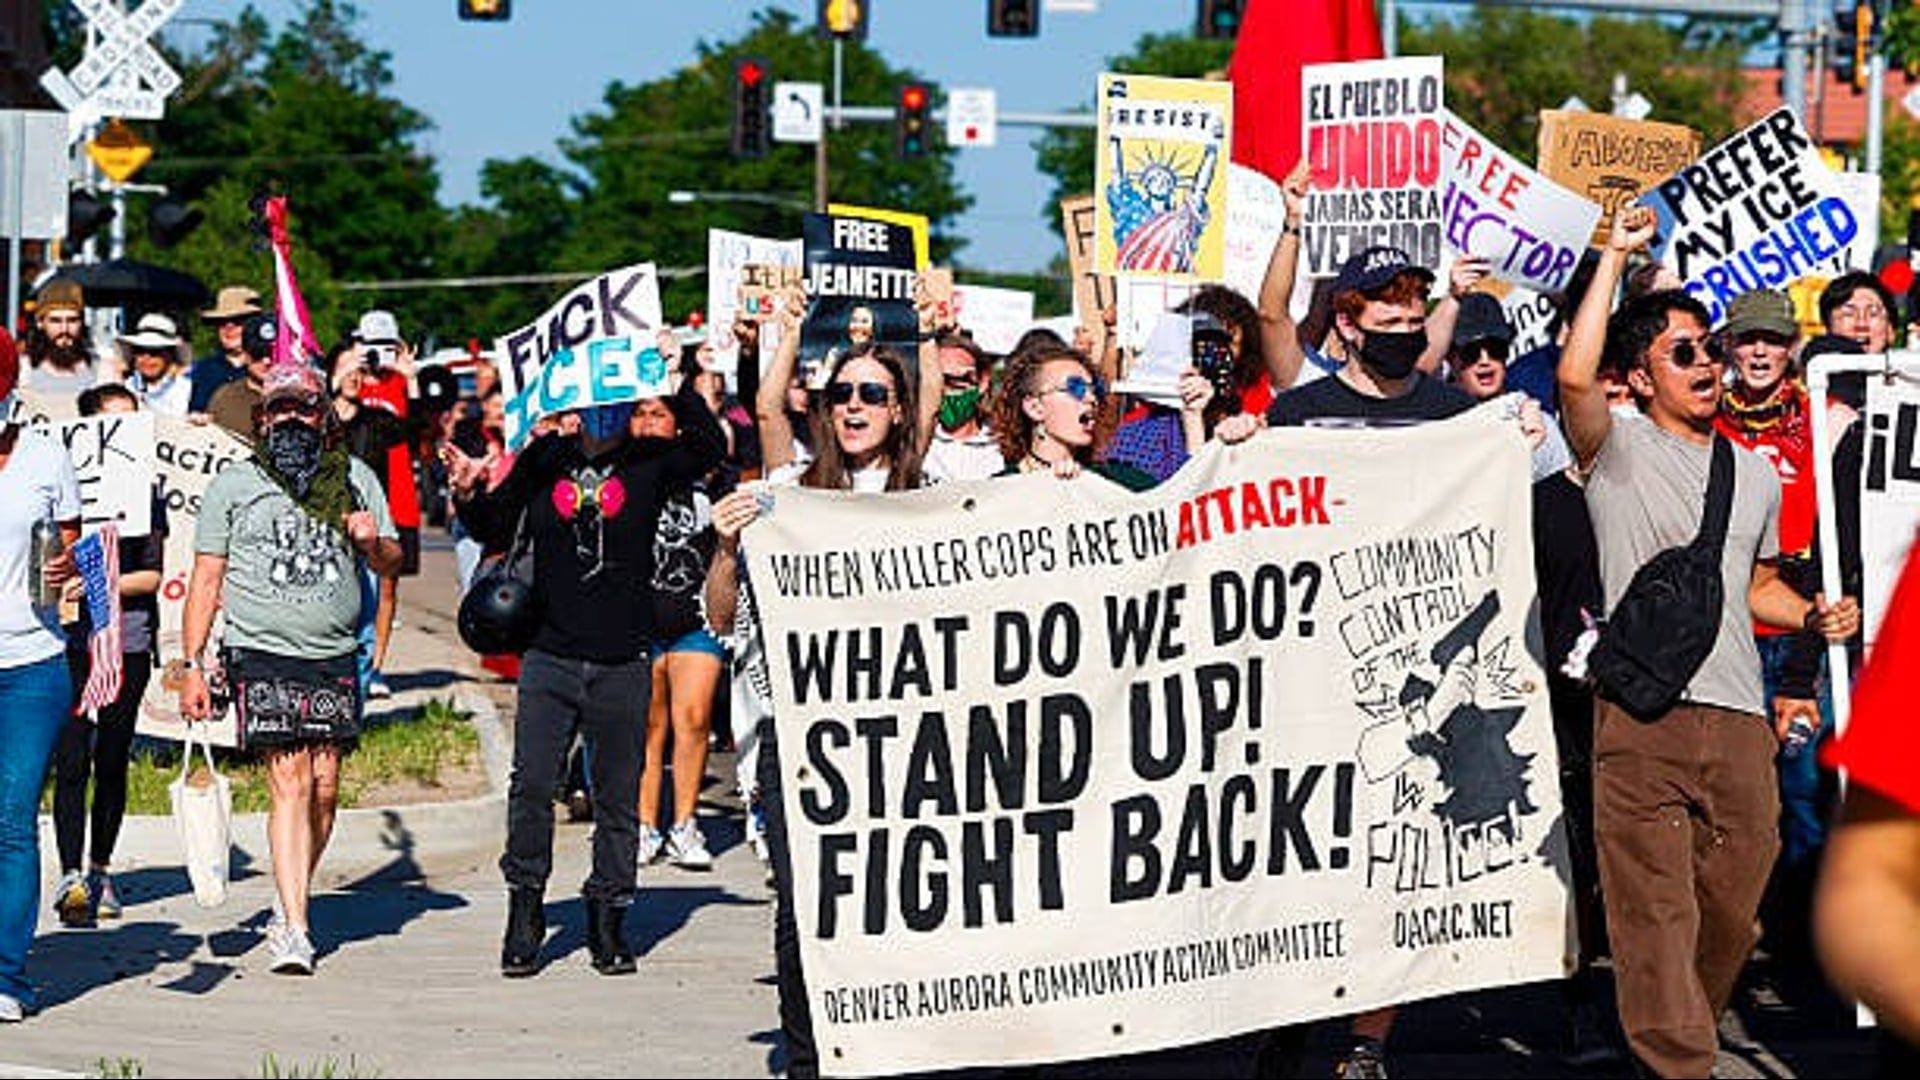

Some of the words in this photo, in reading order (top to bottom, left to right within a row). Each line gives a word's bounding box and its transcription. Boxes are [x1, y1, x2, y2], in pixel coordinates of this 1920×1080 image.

[1118, 109, 1211, 130] RESIST
[1309, 84, 1334, 121] EL
[1340, 75, 1438, 118] PUEBLO
[1308, 119, 1441, 191] UNIDO
[1443, 121, 1530, 211] FREE
[1659, 109, 1808, 226] PREFER
[833, 218, 889, 252] FREE
[1304, 192, 1375, 224] JAMAS
[1380, 189, 1441, 221] SERA
[1675, 208, 1735, 281] MY
[1741, 164, 1817, 233] ICE
[803, 262, 916, 299] JEANETTE
[1683, 197, 1858, 324] CRUSHED
[507, 272, 651, 393] FUCK
[505, 338, 637, 449] ICE
[770, 551, 865, 599] WHEN
[870, 539, 972, 592] KILLER
[976, 526, 1056, 580] COPS
[1068, 518, 1123, 569] ARE
[1128, 507, 1169, 561] ON
[1329, 523, 1500, 601] COMMUNITY
[787, 615, 969, 704] WHAT
[993, 601, 1080, 687] DO
[1105, 584, 1187, 669] WE
[1210, 561, 1322, 647] DO?
[1339, 583, 1475, 660] CONTROL
[1351, 660, 1380, 693] OF
[1386, 640, 1427, 673] THE
[799, 693, 1094, 825] STAND
[1129, 656, 1263, 781] UP!
[816, 808, 1074, 940] FIGHT
[1110, 762, 1356, 904] BACK!
[1394, 899, 1515, 950] DACAC.NET
[823, 983, 912, 1024] DENVER
[917, 971, 1015, 1017] AURORA
[1018, 946, 1158, 1006] COMMUNITY
[1163, 938, 1230, 984] ACTION
[1233, 918, 1346, 973] COMMITTEE
